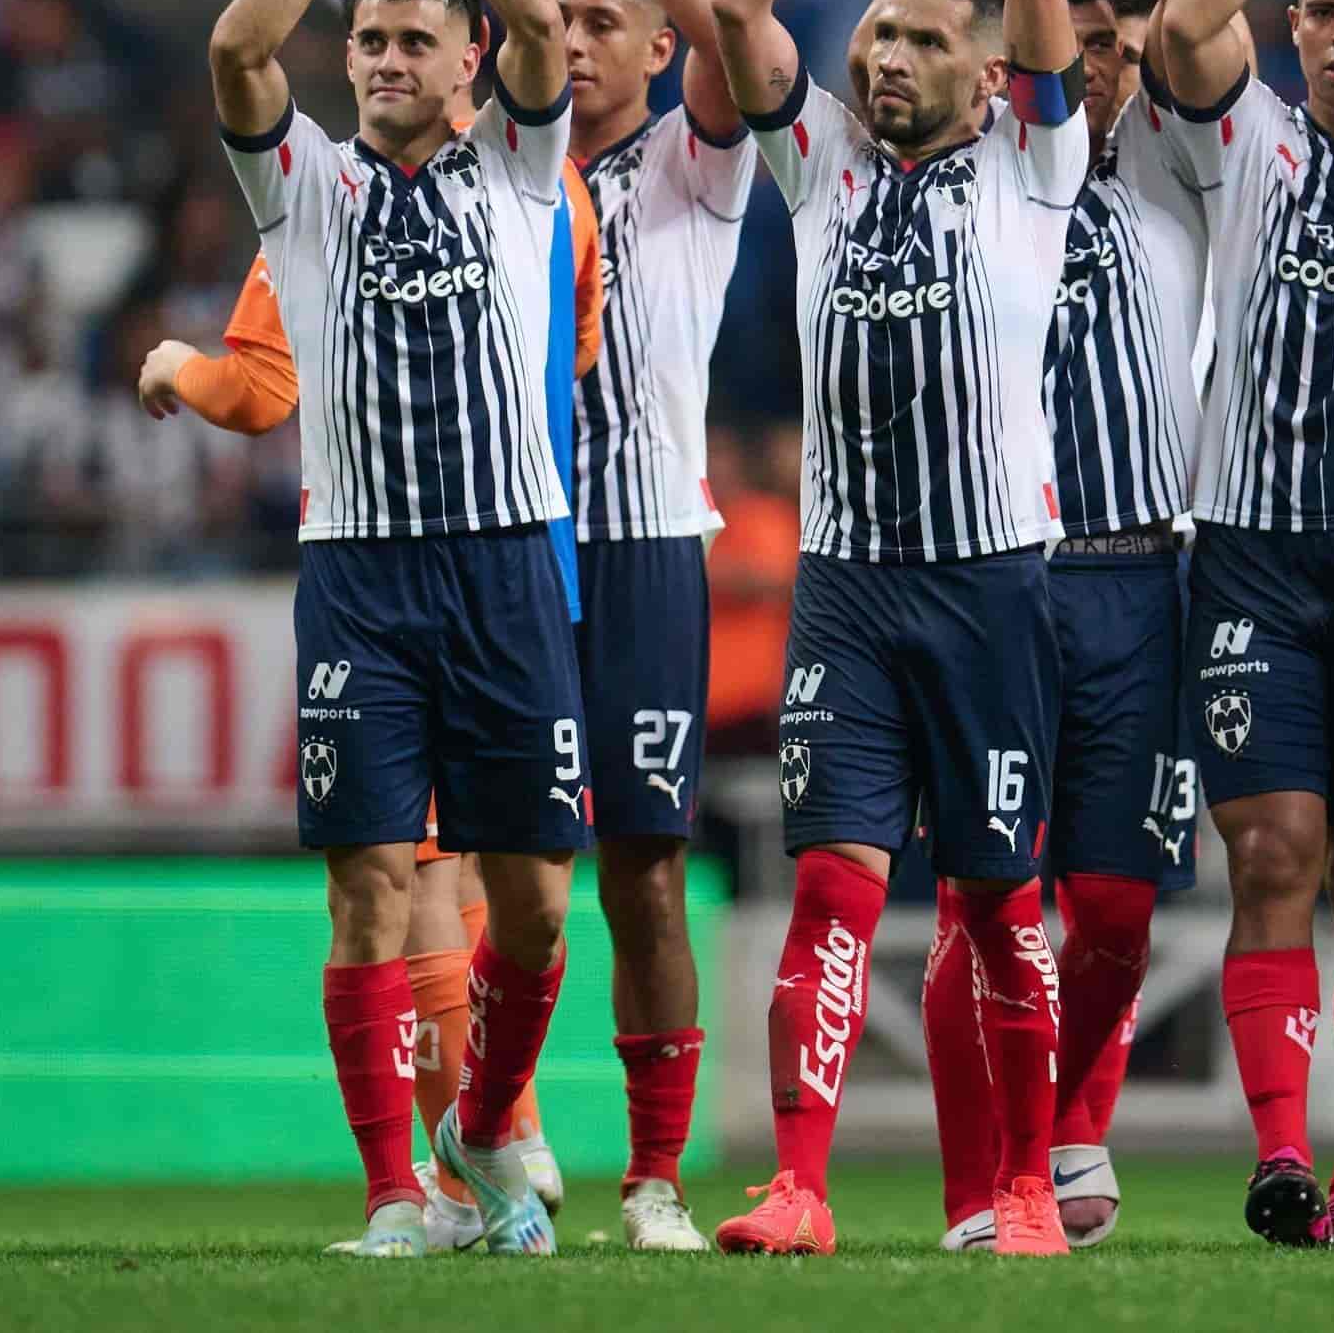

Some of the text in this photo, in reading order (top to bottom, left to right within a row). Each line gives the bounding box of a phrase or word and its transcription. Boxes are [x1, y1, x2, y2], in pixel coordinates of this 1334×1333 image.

[358, 259, 487, 303] codere
[1199, 659, 1270, 681] nowports
[552, 718, 581, 781] 9
[633, 709, 693, 770] 27
[987, 750, 1029, 811] 16
[799, 926, 857, 1107] Escudo
